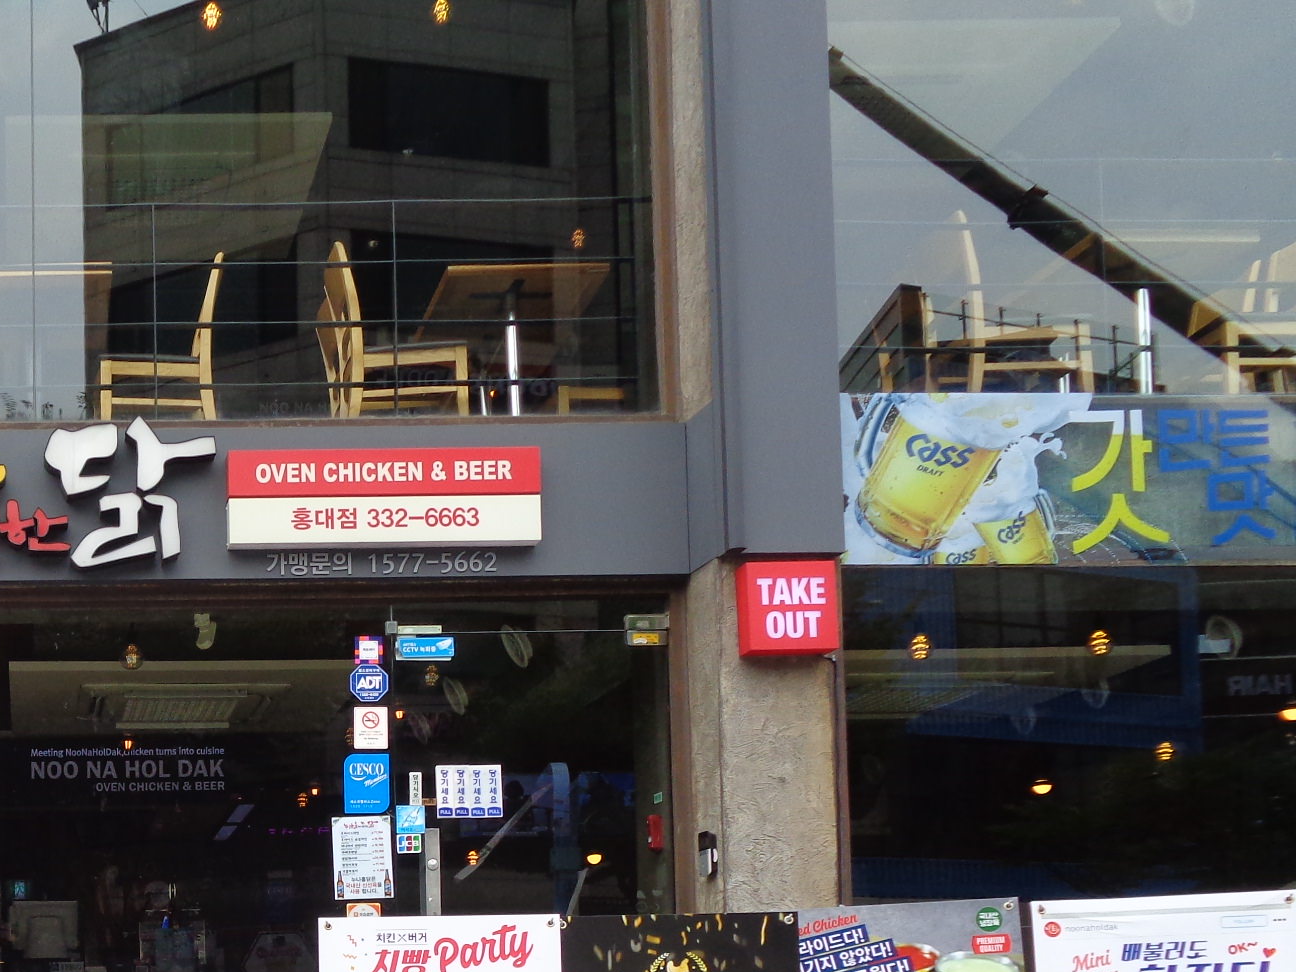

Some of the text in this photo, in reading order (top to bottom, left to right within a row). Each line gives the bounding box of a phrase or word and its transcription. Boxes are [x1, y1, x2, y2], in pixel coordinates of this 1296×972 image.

[906, 432, 978, 469] Cass
[255, 460, 513, 483] OVEN CHICKEN & BEER
[1069, 408, 1277, 555] 갓 만든 맛
[291, 507, 481, 531] 홍대점 332-6663
[266, 551, 499, 576] 가맹문의 1577-5662
[757, 577, 827, 606] TAKE
[765, 610, 822, 639] OUT
[357, 675, 382, 690] ADT
[31, 749, 64, 758] Meeting
[156, 748, 176, 756] turns
[179, 748, 193, 756] into
[196, 747, 225, 756] cuisine
[30, 758, 225, 780] NOO NA HOL DAK
[349, 763, 384, 776] CESCO
[96, 781, 225, 792] OVEN CHICKEN & BEER
[812, 913, 860, 933] Chicken
[839, 941, 893, 968] 않았다!
[1071, 950, 1112, 972] Mini
[1120, 940, 1209, 963] 배불러도
